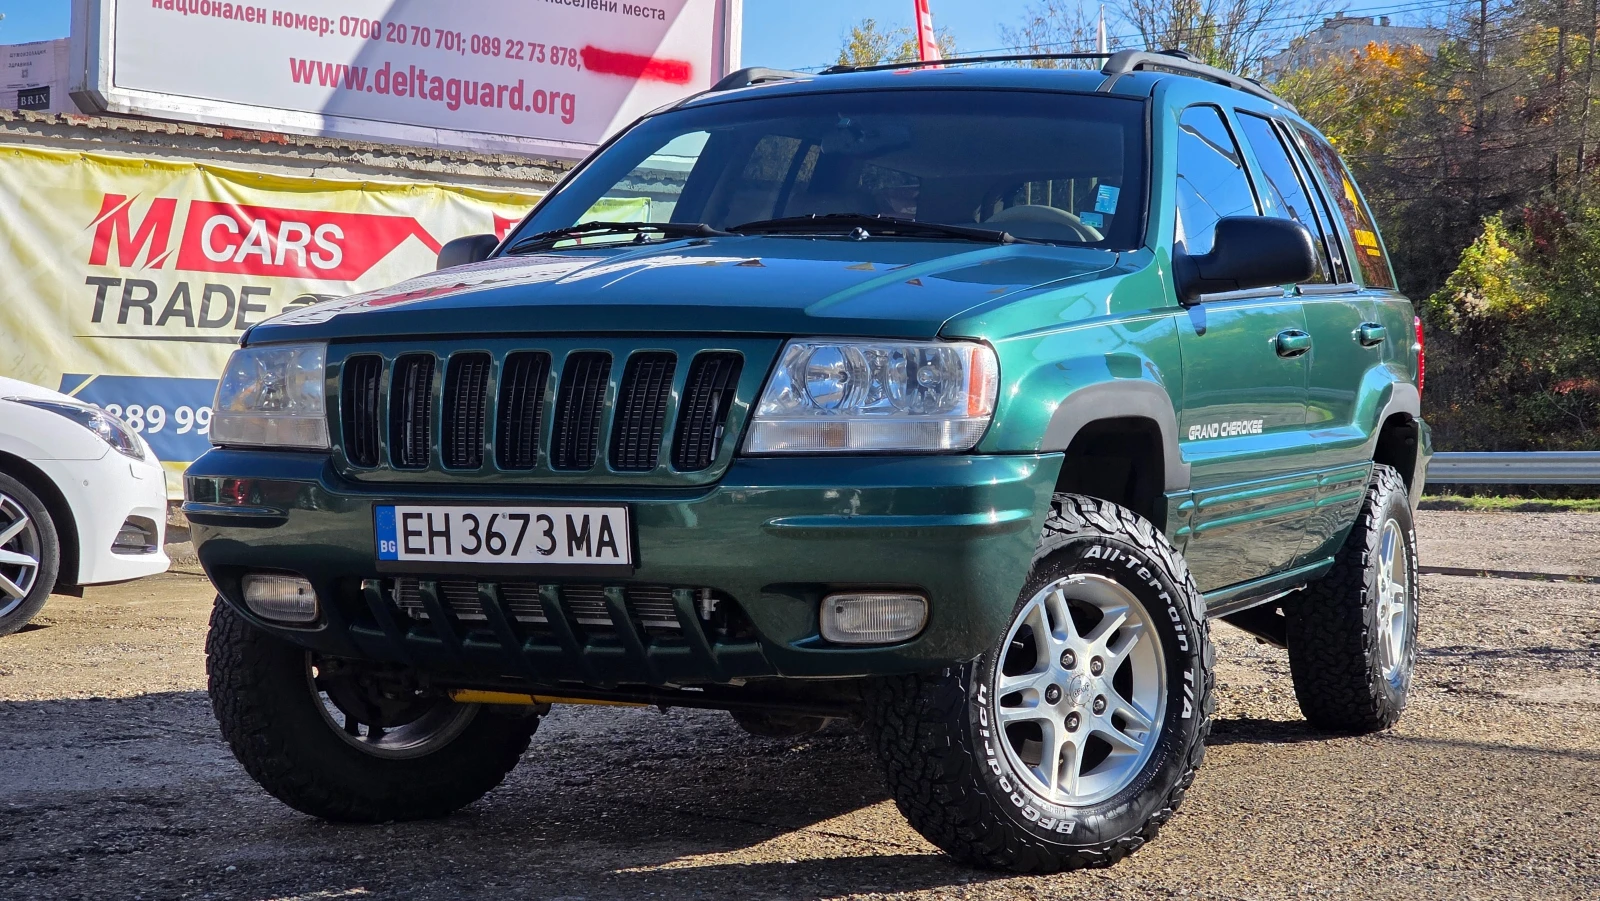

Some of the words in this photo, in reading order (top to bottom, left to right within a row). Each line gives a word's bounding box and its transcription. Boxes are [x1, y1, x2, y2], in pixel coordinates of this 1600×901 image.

[545, 0, 618, 13] селени
[622, 3, 666, 20] места
[272, 10, 335, 38] номер:
[339, 15, 382, 41] 0700
[386, 22, 408, 44] 20
[411, 25, 431, 47] 70
[434, 29, 467, 56] 701;
[470, 34, 501, 57] 089
[505, 39, 525, 60] 22
[527, 42, 546, 63] 73
[550, 46, 582, 72] 878,
[21, 94, 47, 106] BRIX
[289, 57, 577, 125] www.deltaguard.org
[84, 191, 178, 271] M
[201, 214, 345, 270] CARS
[85, 275, 272, 330] TRADE
[1188, 422, 1220, 441] GRAND
[1220, 419, 1264, 437] CHEROKEE
[380, 540, 397, 553] BG
[1084, 545, 1189, 652] All-Terrain
[1180, 668, 1196, 719] T/A
[977, 683, 1077, 835] BFGoodrich
